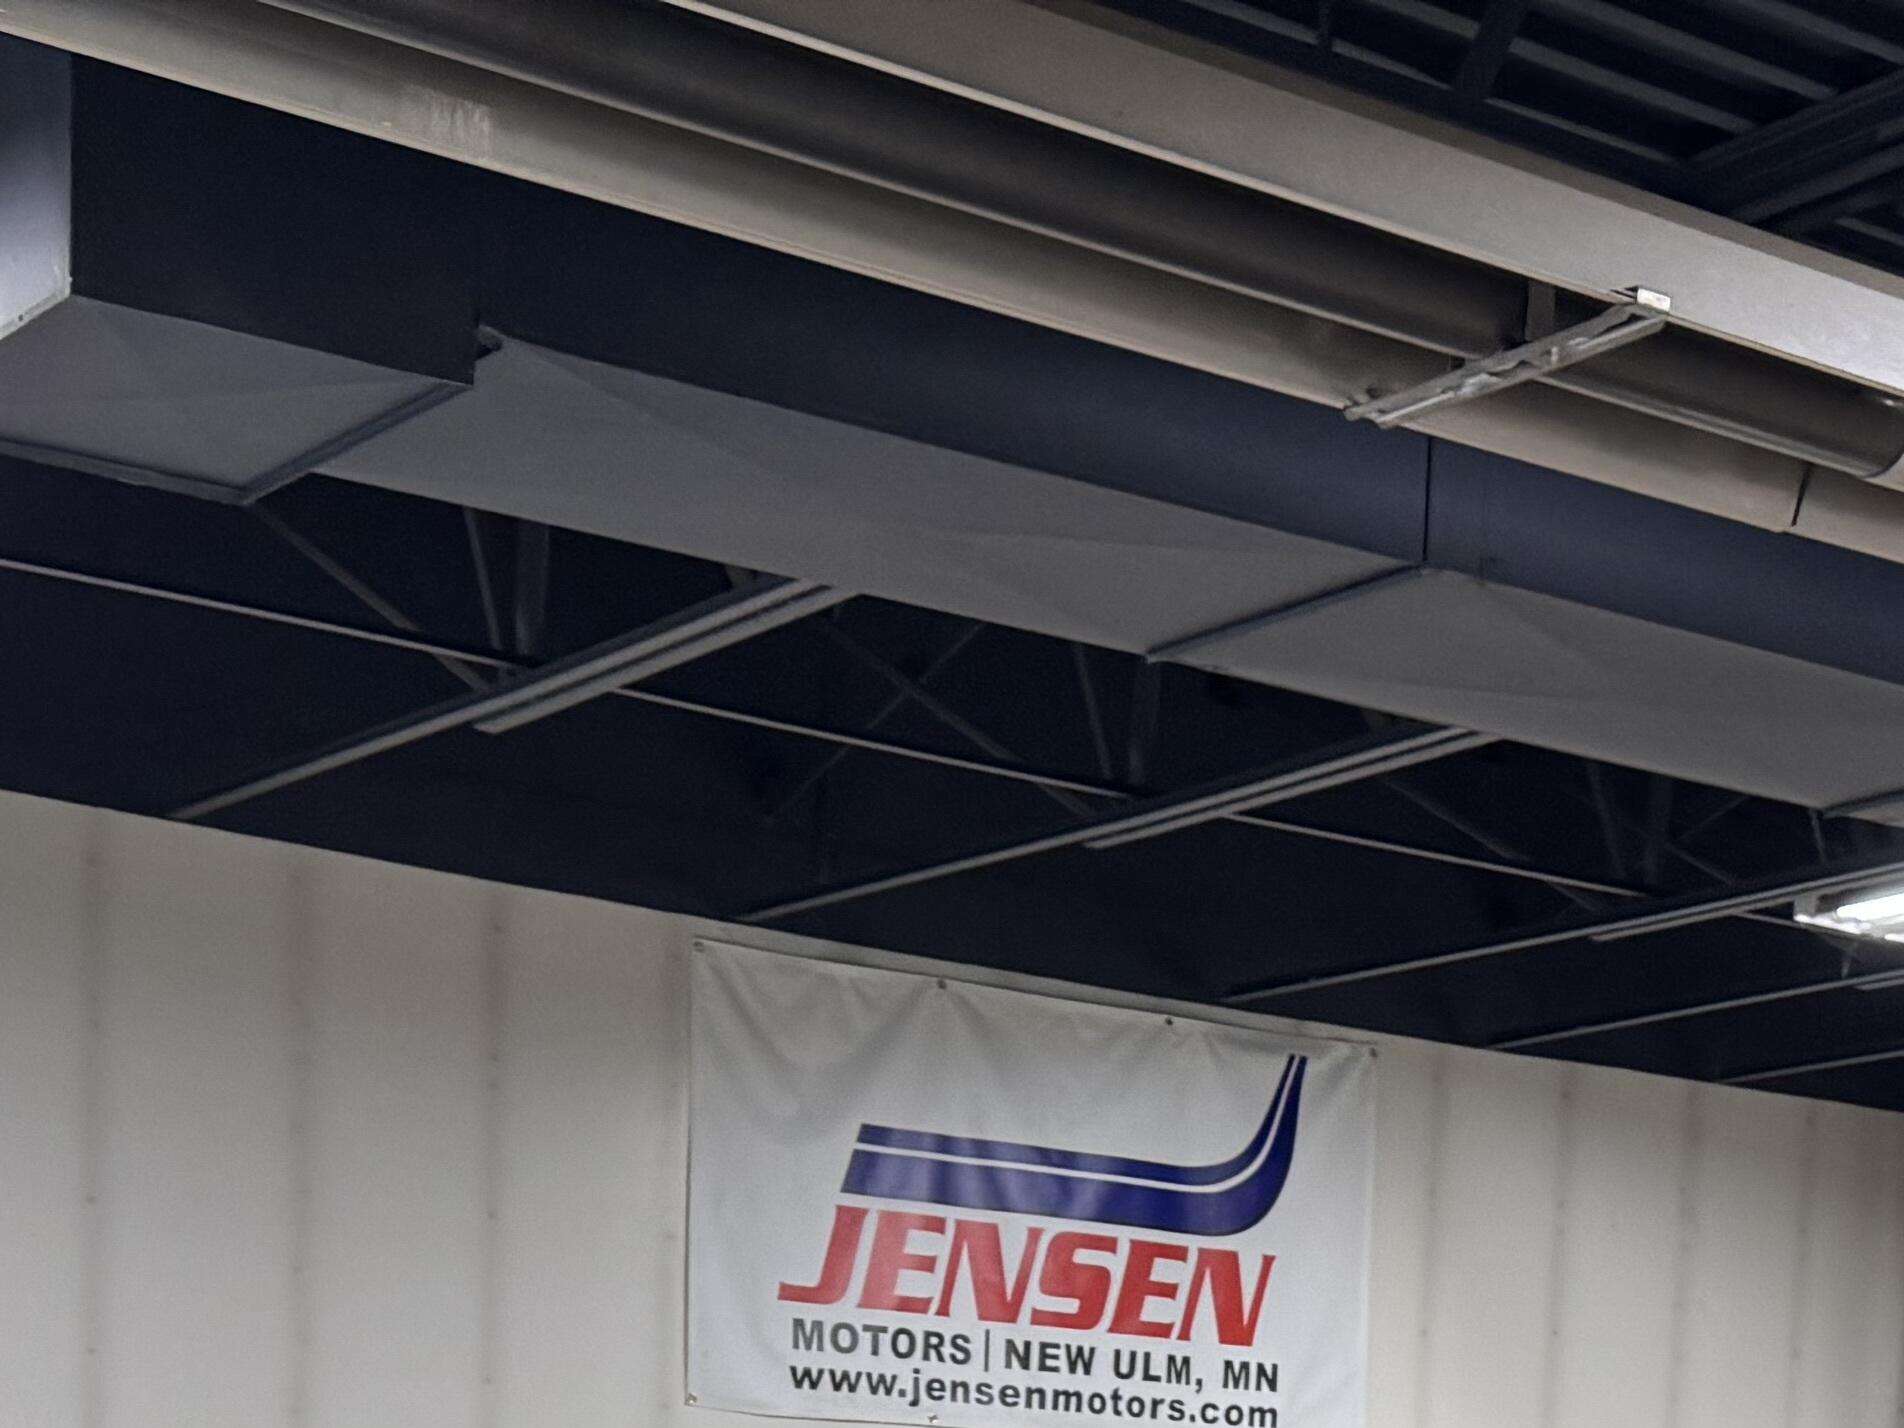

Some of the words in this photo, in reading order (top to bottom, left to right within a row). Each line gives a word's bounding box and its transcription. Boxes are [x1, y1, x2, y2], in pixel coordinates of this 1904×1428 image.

[777, 1204, 1276, 1347] JENSEN
[791, 1317, 972, 1366] MOTORS
[1004, 1338, 1097, 1377] NEW
[1112, 1350, 1204, 1393] ULM,
[1221, 1359, 1279, 1393] MN
